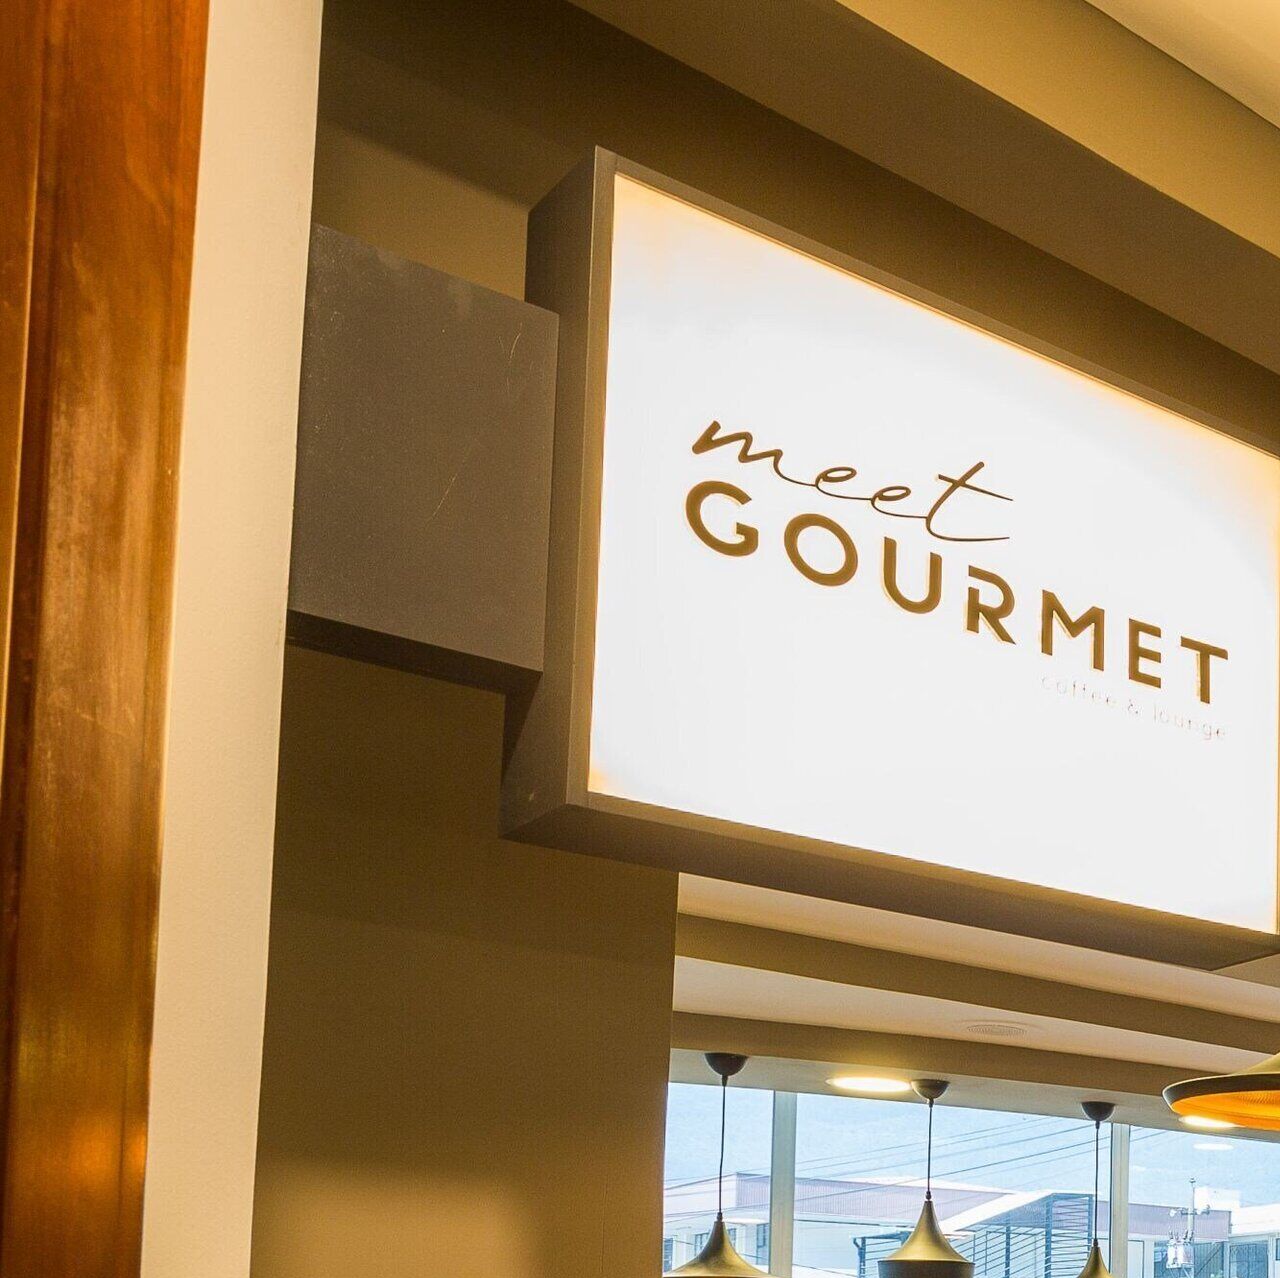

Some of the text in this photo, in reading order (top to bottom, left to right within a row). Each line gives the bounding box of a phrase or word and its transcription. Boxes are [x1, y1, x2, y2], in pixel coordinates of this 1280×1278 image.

[691, 420, 1013, 541] meet
[685, 480, 1229, 704] GOURMET
[1041, 675, 1119, 707] coffee
[1153, 702, 1226, 741] lounge
